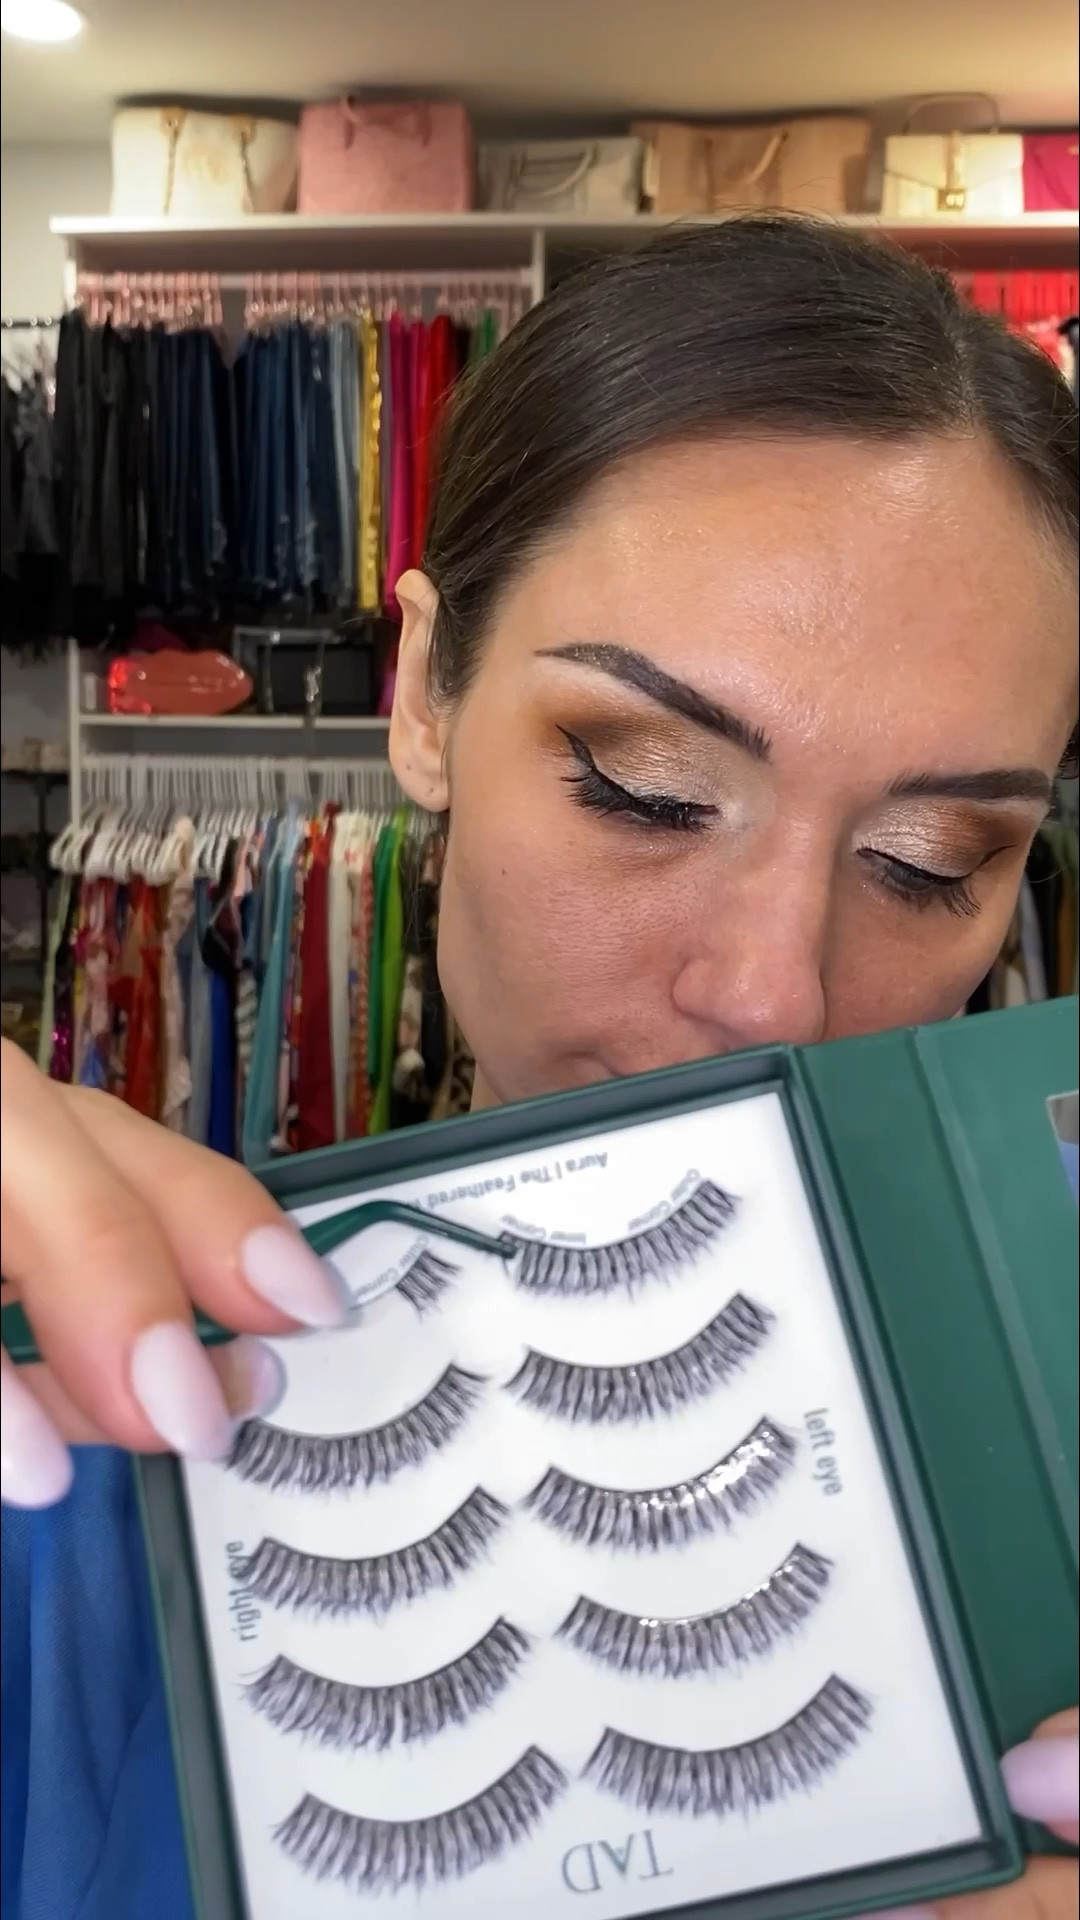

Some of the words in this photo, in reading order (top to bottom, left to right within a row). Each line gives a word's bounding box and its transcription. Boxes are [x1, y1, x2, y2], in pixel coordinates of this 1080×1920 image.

[520, 1165, 554, 1184] The
[565, 1152, 608, 1172] Aura
[427, 1173, 516, 1210] Feathered
[803, 1406, 836, 1452] left
[812, 1455, 844, 1496] eye
[228, 1588, 262, 1641] right
